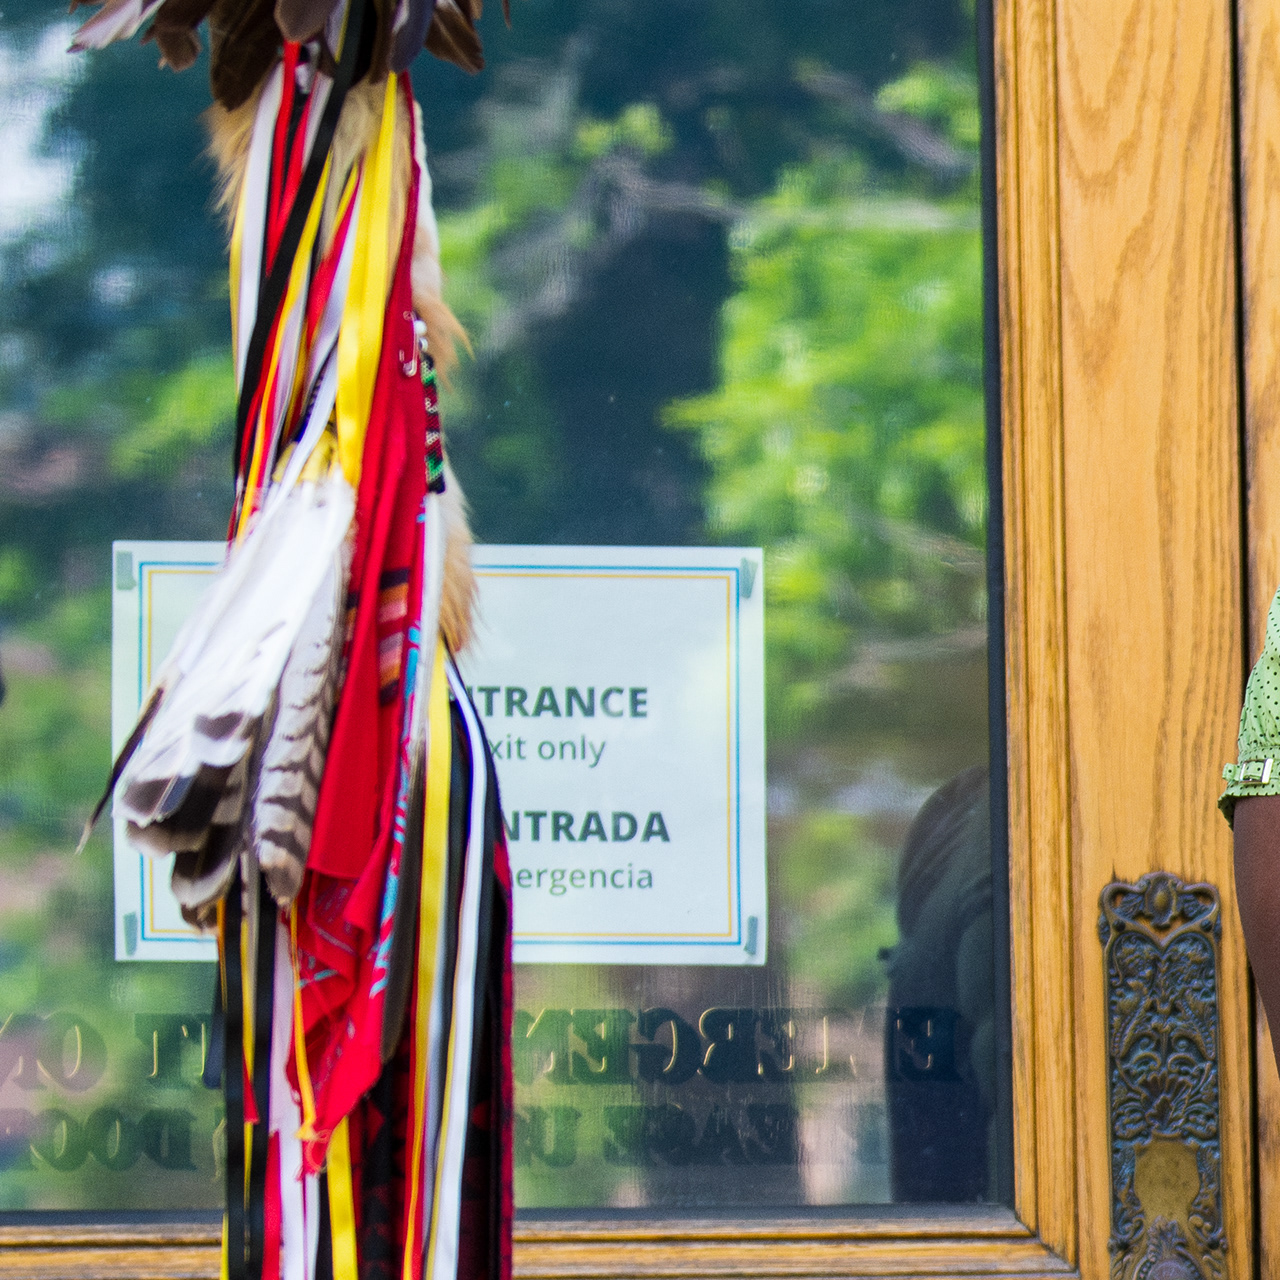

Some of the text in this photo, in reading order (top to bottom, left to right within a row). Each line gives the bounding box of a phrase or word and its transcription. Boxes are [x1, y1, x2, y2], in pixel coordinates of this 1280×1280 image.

[470, 686, 649, 719] TRANCE
[489, 733, 606, 769] xit only
[503, 810, 671, 843] NTRADA
[513, 862, 653, 896] ergencia
